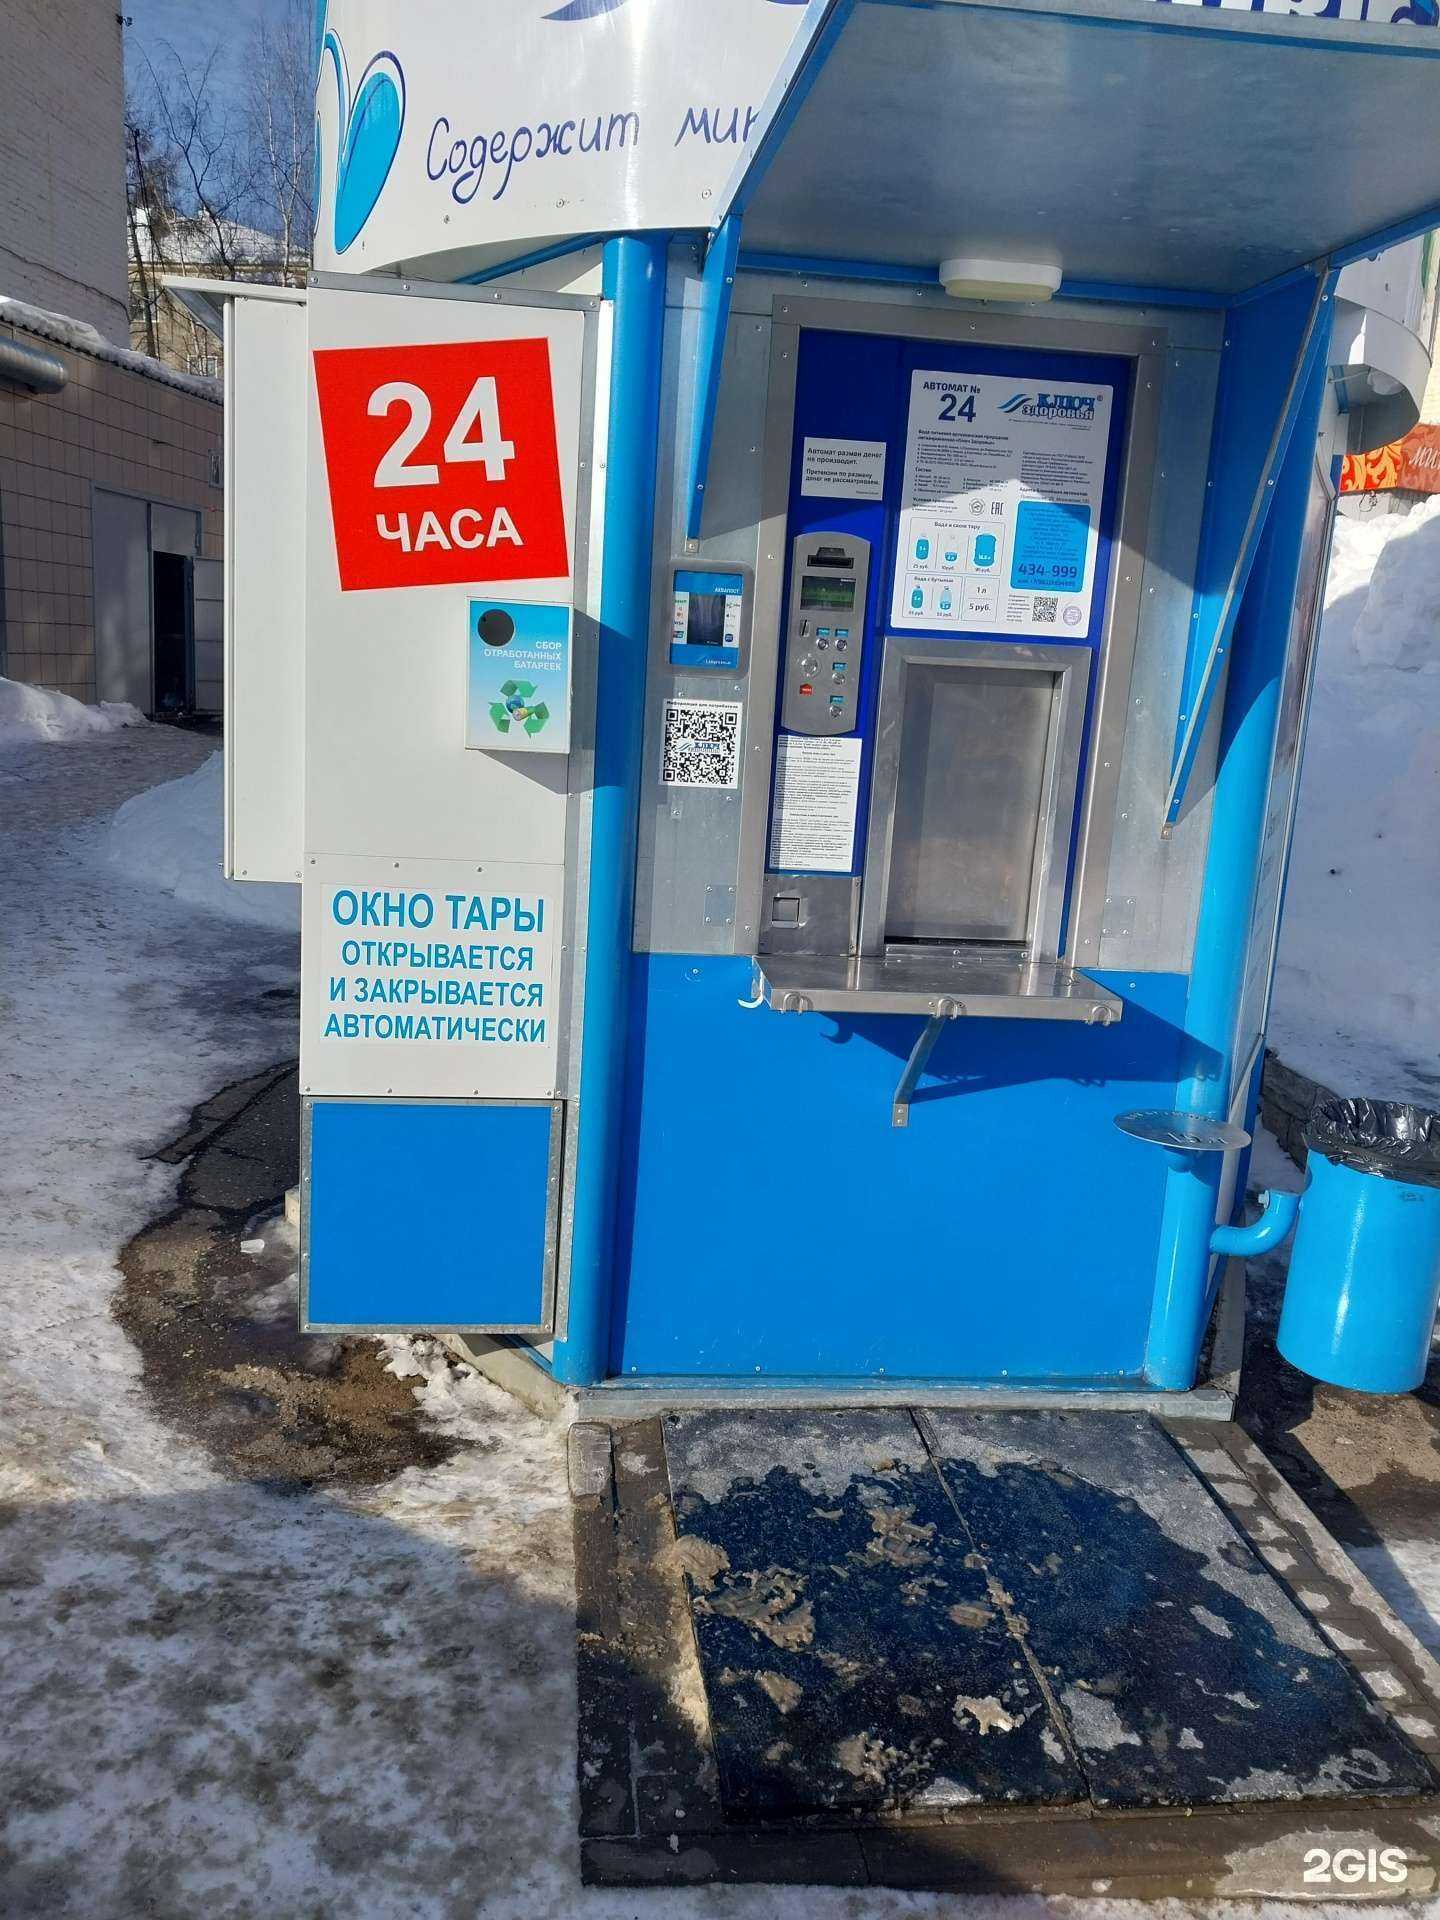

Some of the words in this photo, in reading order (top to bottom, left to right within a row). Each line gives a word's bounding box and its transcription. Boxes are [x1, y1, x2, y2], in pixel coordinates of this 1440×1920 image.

[427, 112, 641, 205] Содержит
[923, 381, 968, 393] АВТОМАТ
[970, 386, 981, 394] №
[938, 393, 977, 423] 24
[1036, 393, 1096, 409] КЛЮЧ
[367, 376, 516, 488] 24
[807, 447, 836, 456] Автомат
[863, 451, 883, 459] денег
[816, 457, 858, 465] производит.
[806, 468, 838, 476] Претензии
[375, 507, 524, 552] ЧАСА
[975, 604, 991, 612] руб.
[535, 640, 562, 650] СБОР
[483, 648, 561, 661] ОТРАБОТАННЫХ
[513, 660, 561, 671] БАТАРЕЕК
[332, 889, 434, 928] ОКНО
[445, 894, 545, 933] ТАРЫ
[341, 939, 534, 972] ОТКРЫВАЕТСЯ
[329, 976, 347, 1002] И
[353, 977, 544, 1007] ЗАКРЫВАЕТСЯ
[323, 1013, 546, 1044] АВТОМАТИЧЕСКИ
